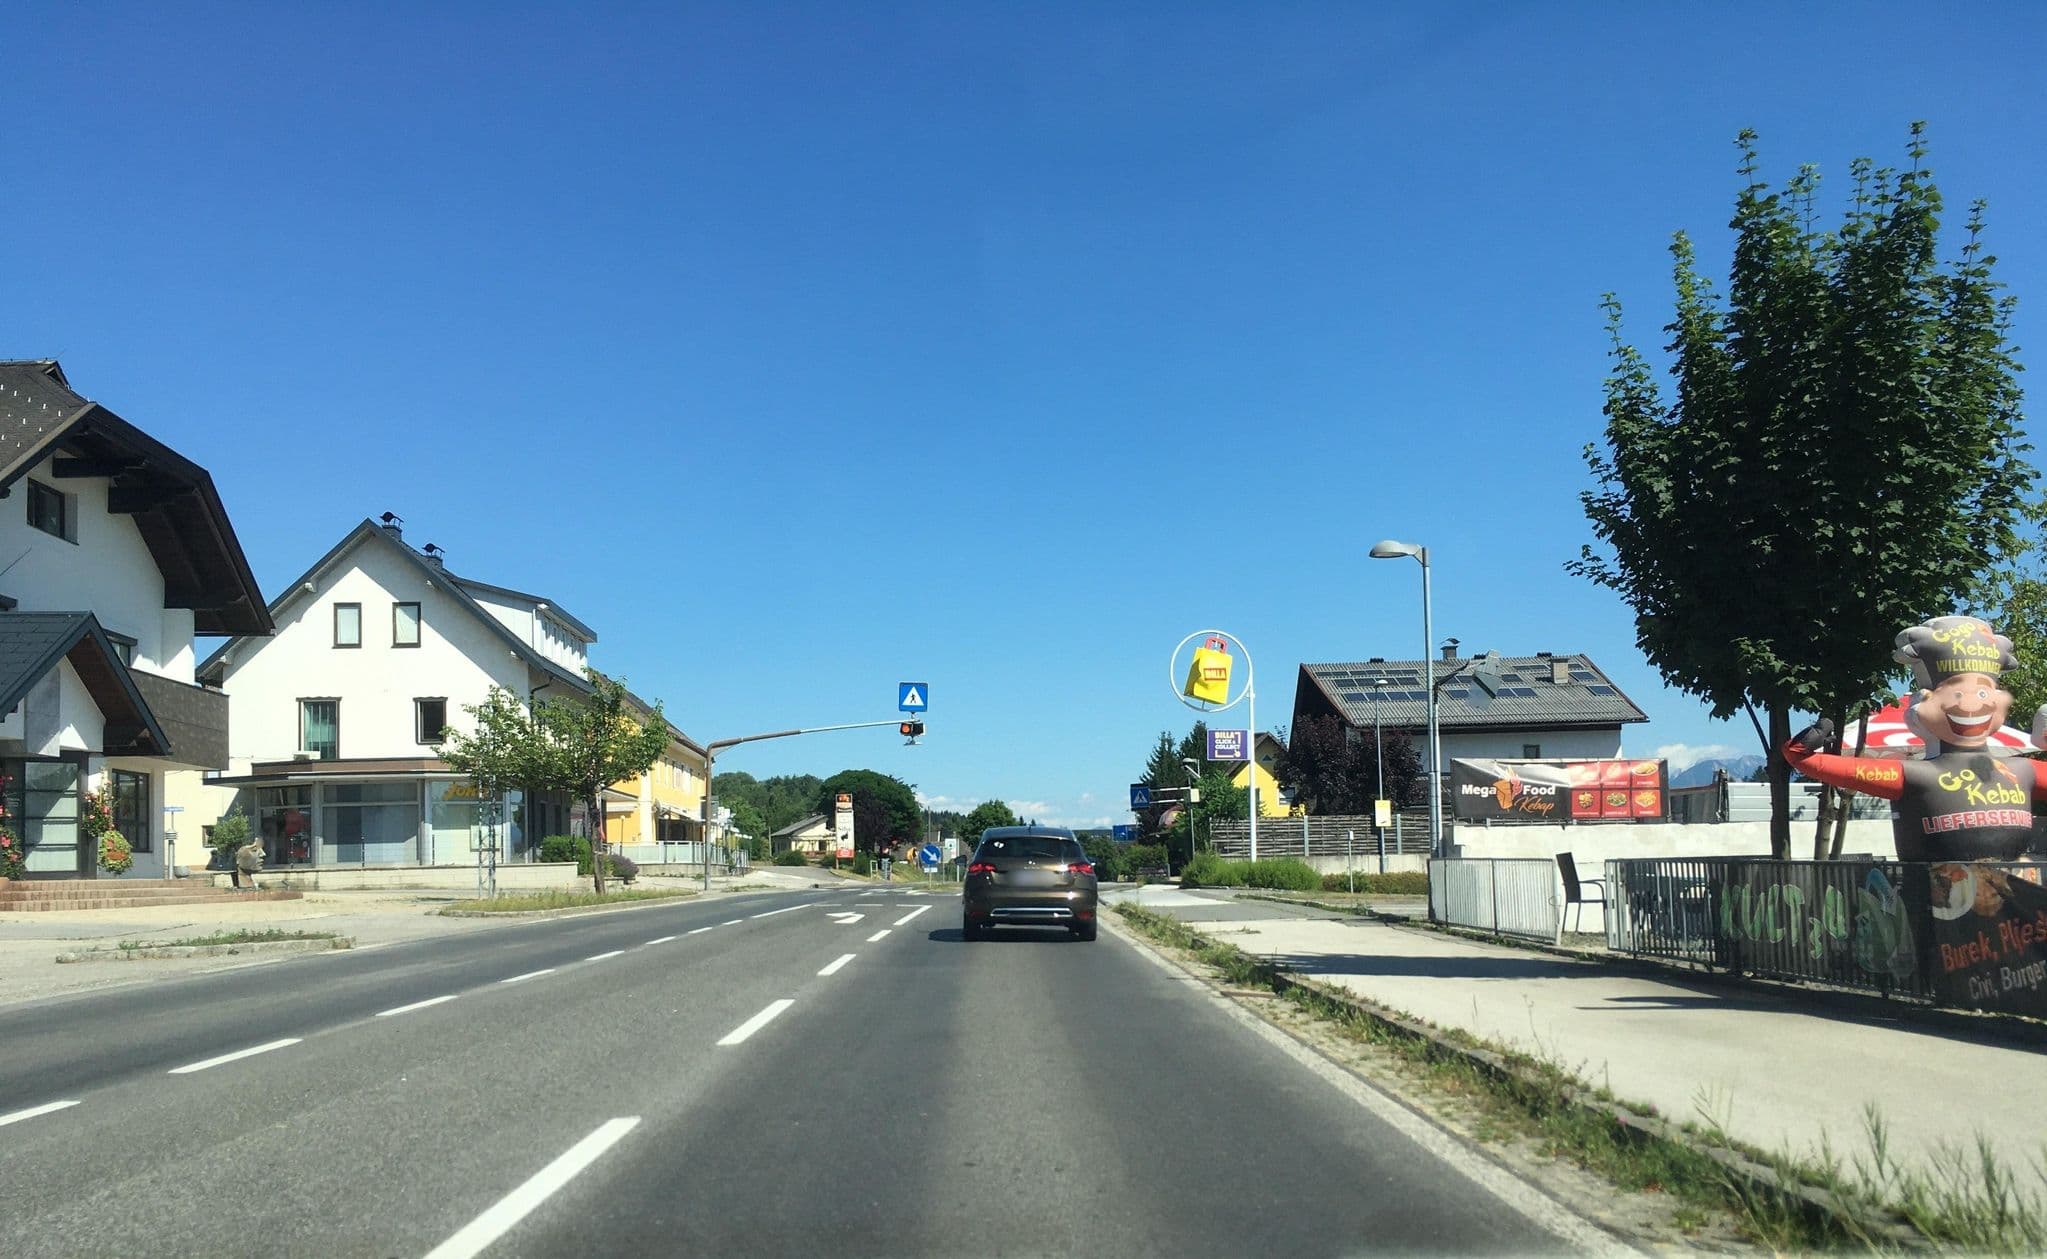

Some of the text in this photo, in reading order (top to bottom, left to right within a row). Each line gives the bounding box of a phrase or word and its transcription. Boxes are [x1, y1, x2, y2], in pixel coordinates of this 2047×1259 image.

[1952, 638, 2001, 660] Kebab
[1215, 731, 1234, 739] BILLA
[1855, 765, 1898, 782] Kebab
[1938, 769, 1975, 792] Go
[1461, 784, 1556, 797] Mega Food
[1967, 781, 2026, 806] Kebab
[1514, 796, 1555, 816] Kebap
[1941, 930, 2000, 973] Burek,
